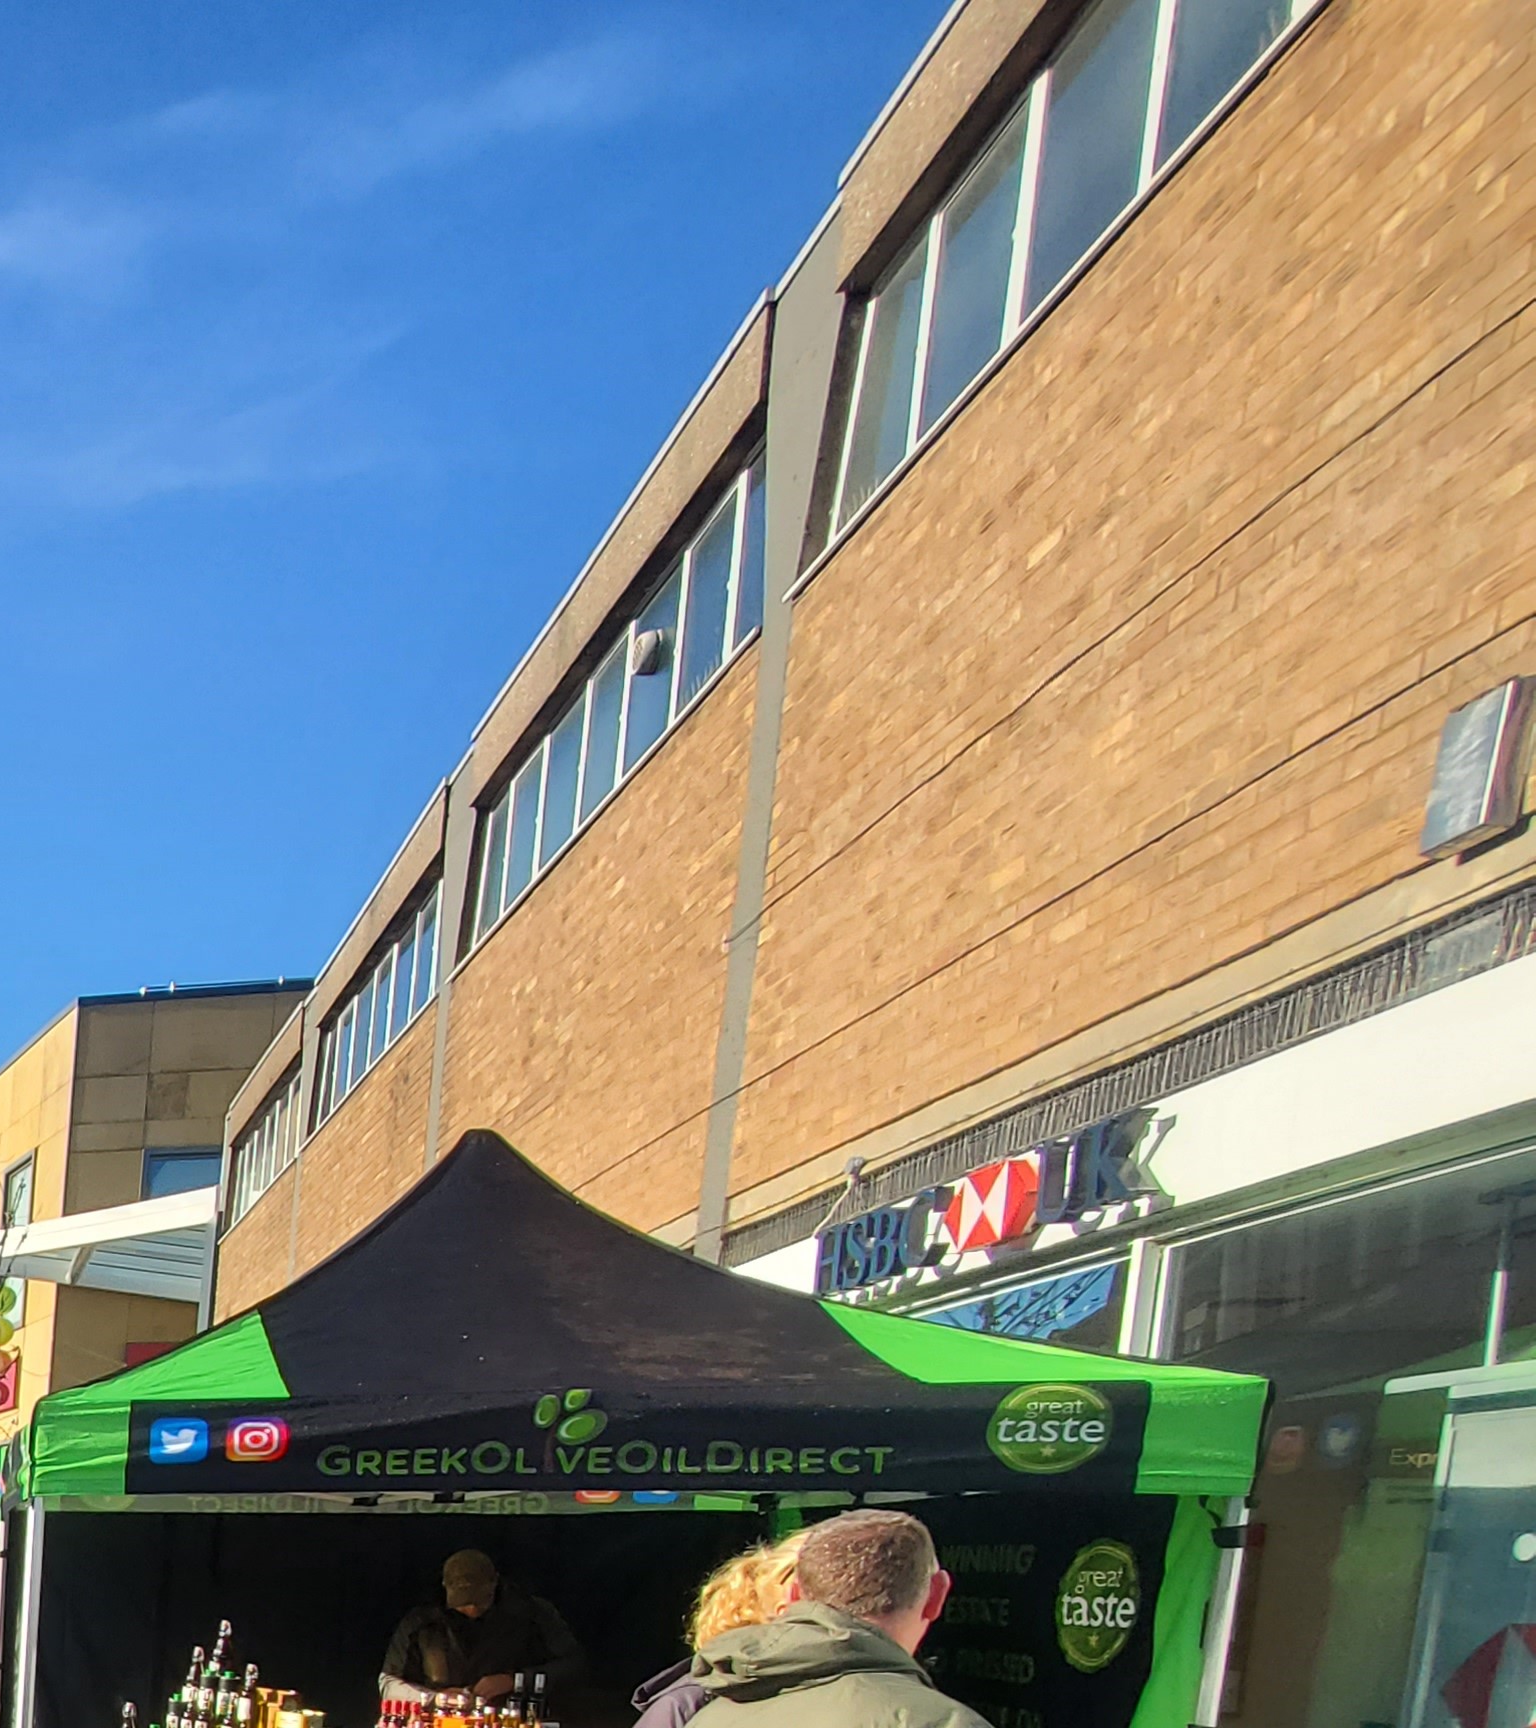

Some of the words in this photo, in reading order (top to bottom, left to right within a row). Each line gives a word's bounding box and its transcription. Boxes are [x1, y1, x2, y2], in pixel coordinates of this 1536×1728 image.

[814, 1186, 954, 1294] HSBC
[1036, 1108, 1160, 1224] UK
[1024, 1399, 1084, 1419] great
[996, 1417, 1105, 1443] taste
[1389, 1447, 1439, 1469] Expr
[1074, 1566, 1124, 1594] great
[1061, 1592, 1136, 1628] taste
